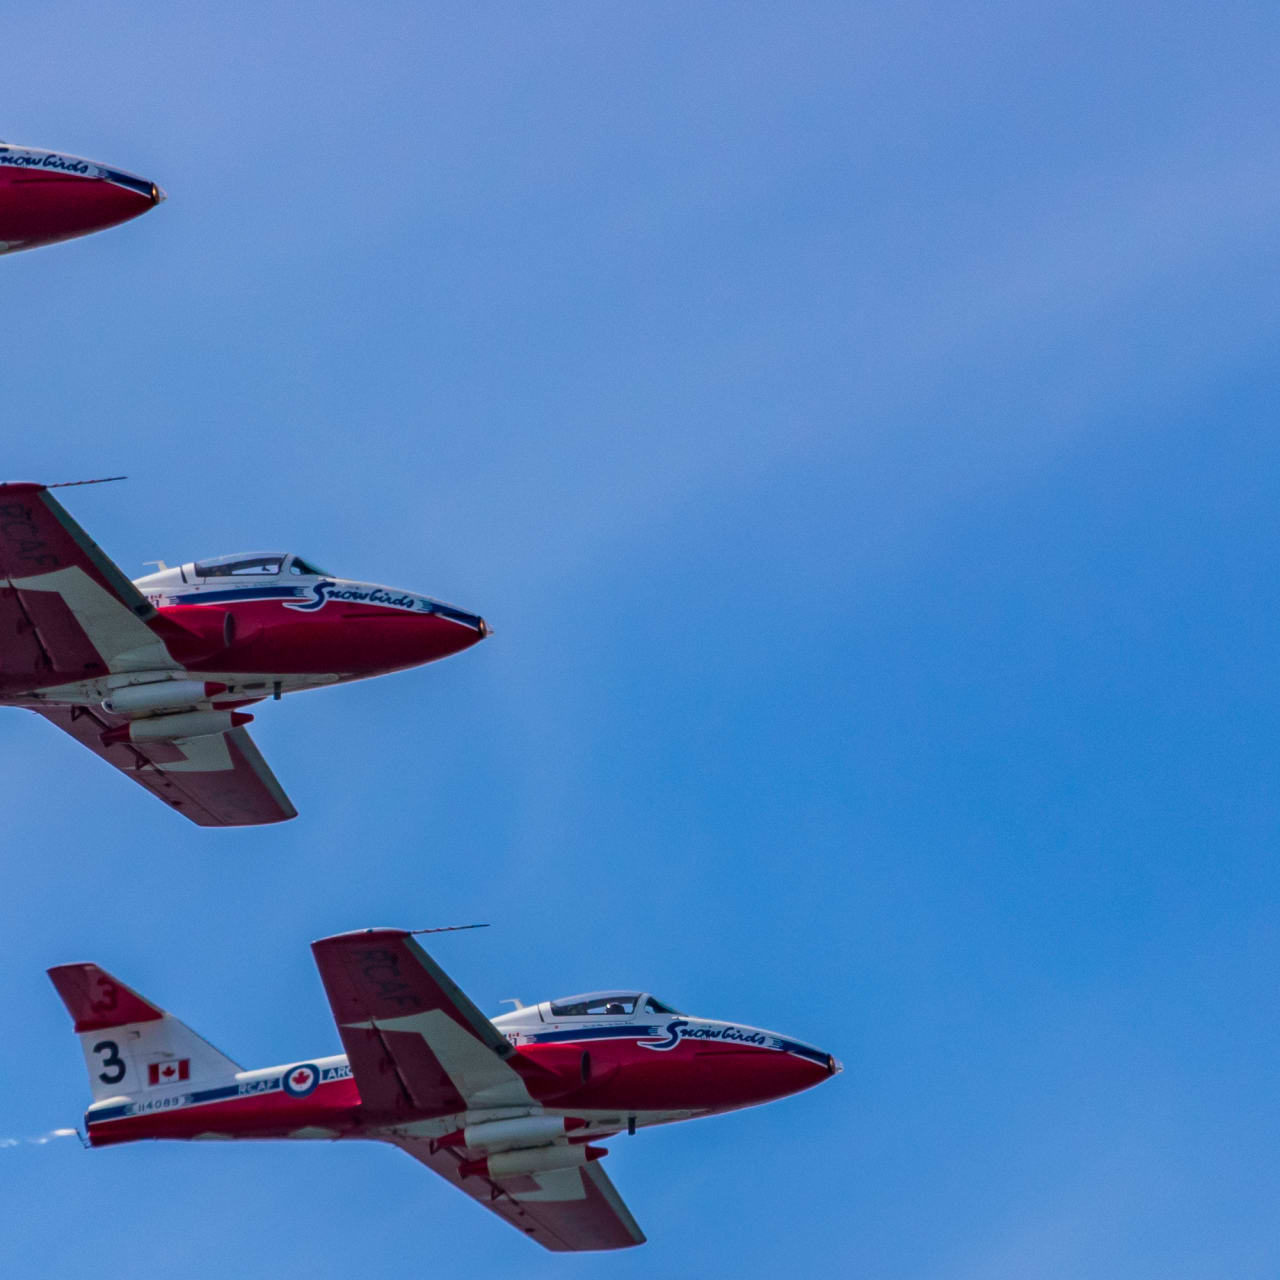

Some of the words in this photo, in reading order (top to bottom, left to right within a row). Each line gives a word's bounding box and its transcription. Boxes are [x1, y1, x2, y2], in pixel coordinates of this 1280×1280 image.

[284, 582, 415, 611] Snowbirds
[639, 1020, 766, 1050] Snowbirds
[92, 1040, 126, 1085] 3
[239, 1079, 274, 1096] RCAF
